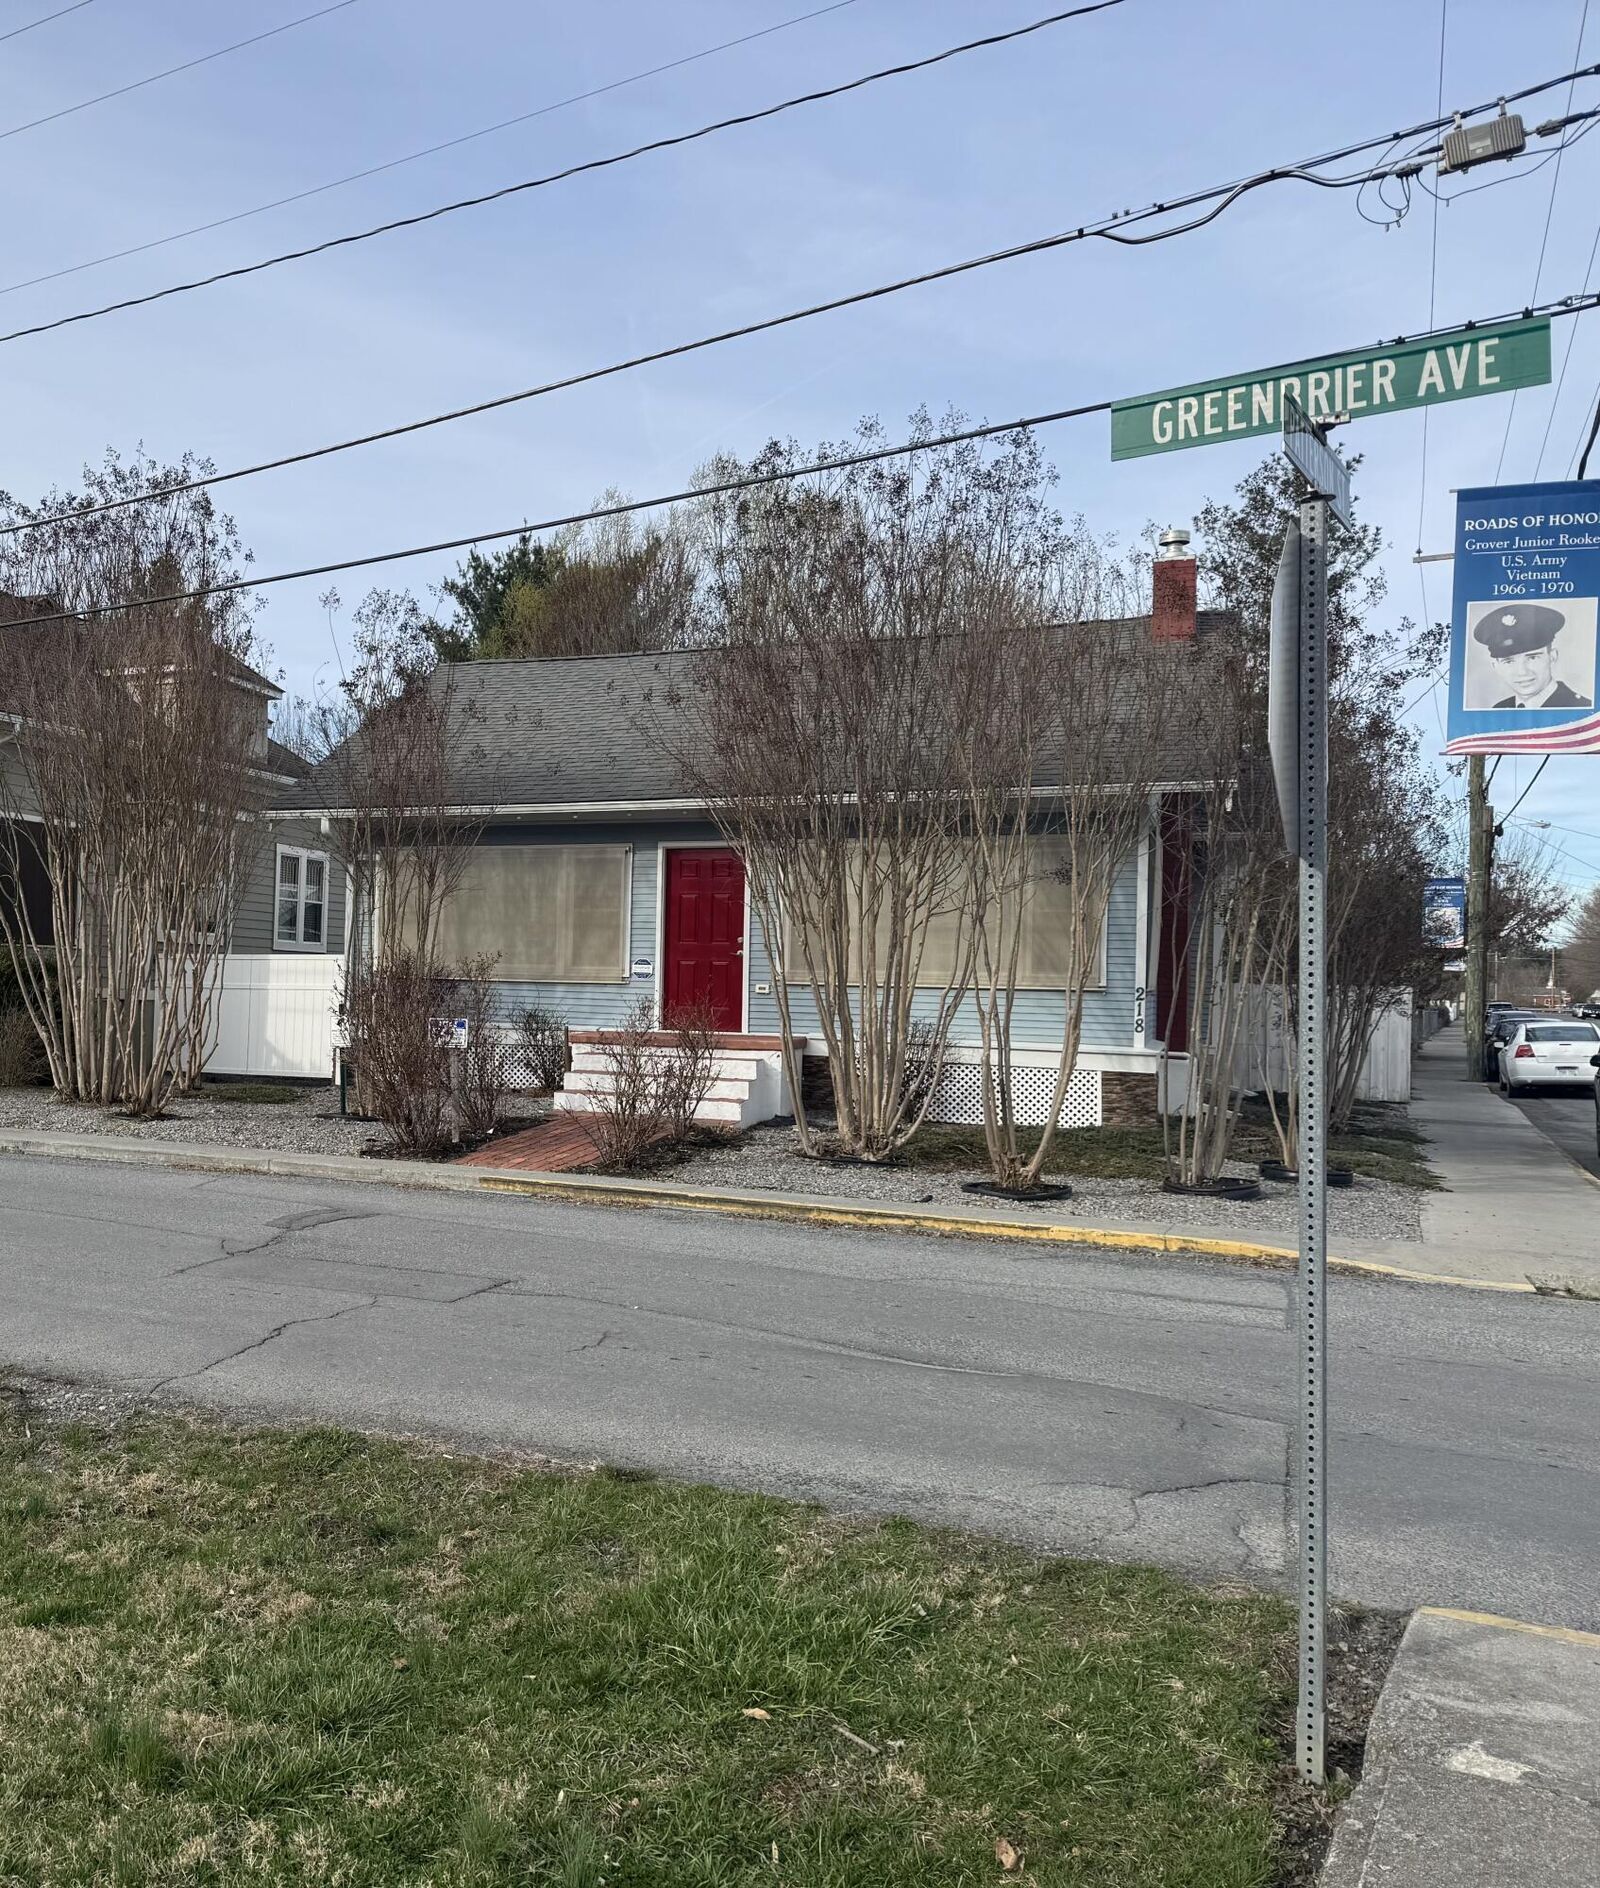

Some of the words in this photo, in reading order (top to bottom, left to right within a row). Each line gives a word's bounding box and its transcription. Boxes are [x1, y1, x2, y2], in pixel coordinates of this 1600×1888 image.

[1417, 337, 1500, 397] AVE
[1464, 517, 1518, 531] ROADS
[1522, 515, 1545, 528] OF
[1549, 512, 1600, 526] HONO
[1465, 539, 1510, 550] Grover
[1513, 536, 1556, 549] Junior
[1502, 555, 1527, 567] U.S.
[1532, 554, 1567, 568] Army
[1507, 569, 1560, 581] Vietnam
[1492, 583, 1526, 595] 1966
[1540, 581, 1575, 594] 1970
[1135, 987, 1145, 1033] 218
